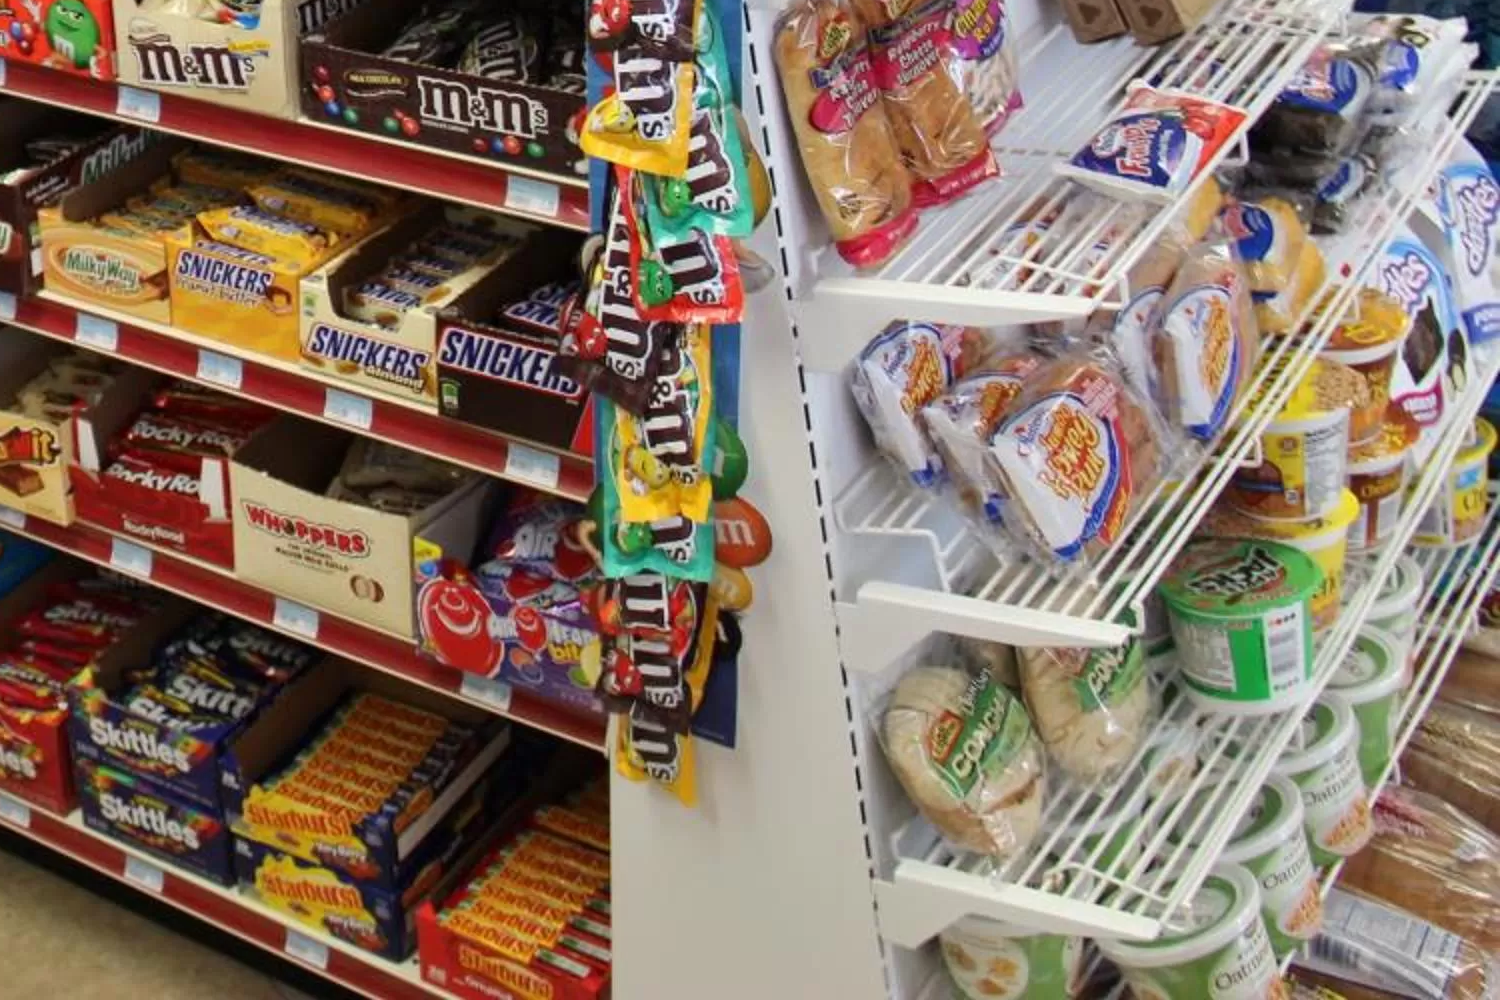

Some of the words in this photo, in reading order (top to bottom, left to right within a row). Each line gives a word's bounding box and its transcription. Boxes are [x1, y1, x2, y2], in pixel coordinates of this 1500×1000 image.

[136, 42, 256, 90] m&m's
[418, 74, 549, 139] m&m's
[176, 250, 275, 297] SNICKERS
[310, 324, 430, 379] SNICKERS
[245, 503, 368, 555] WHOPPERS
[167, 673, 256, 718] Skitt
[88, 717, 192, 775] Skittles
[99, 792, 202, 852] Skittles
